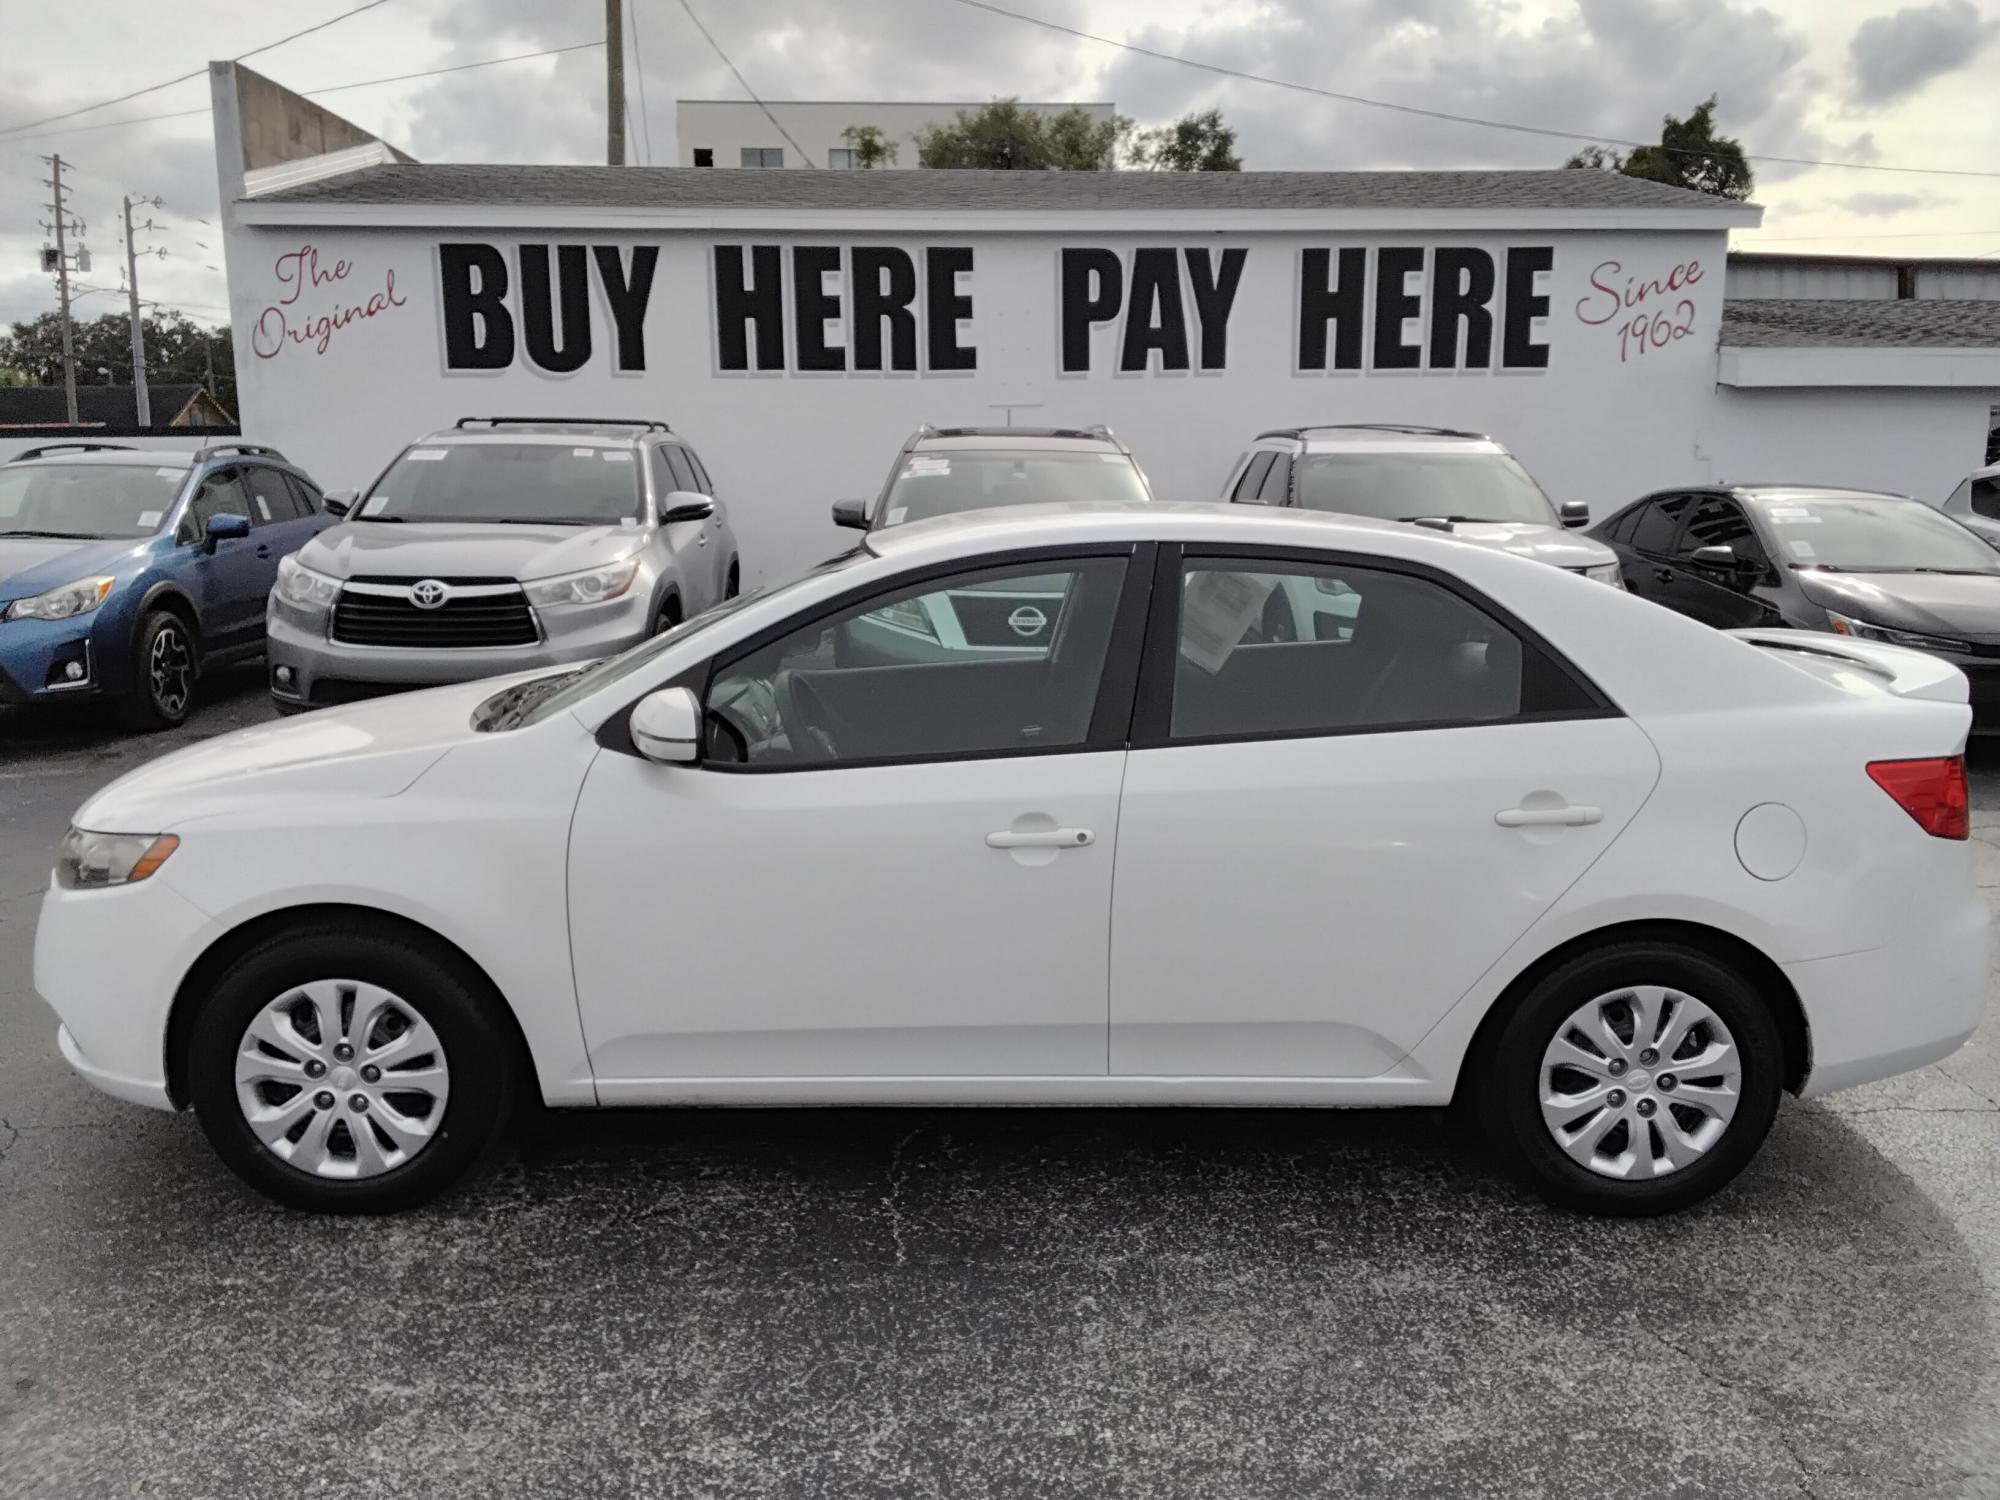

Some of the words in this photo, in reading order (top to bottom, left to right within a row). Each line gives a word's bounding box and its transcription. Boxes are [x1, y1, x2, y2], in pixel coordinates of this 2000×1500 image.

[275, 245, 353, 305] The
[438, 242, 661, 373] BUY
[713, 244, 978, 372] HERE
[1061, 247, 1249, 372] PAY
[1298, 246, 1555, 370] HERE
[1576, 260, 1705, 325] Since
[252, 269, 408, 359] Original
[1617, 299, 1695, 363] 1962
